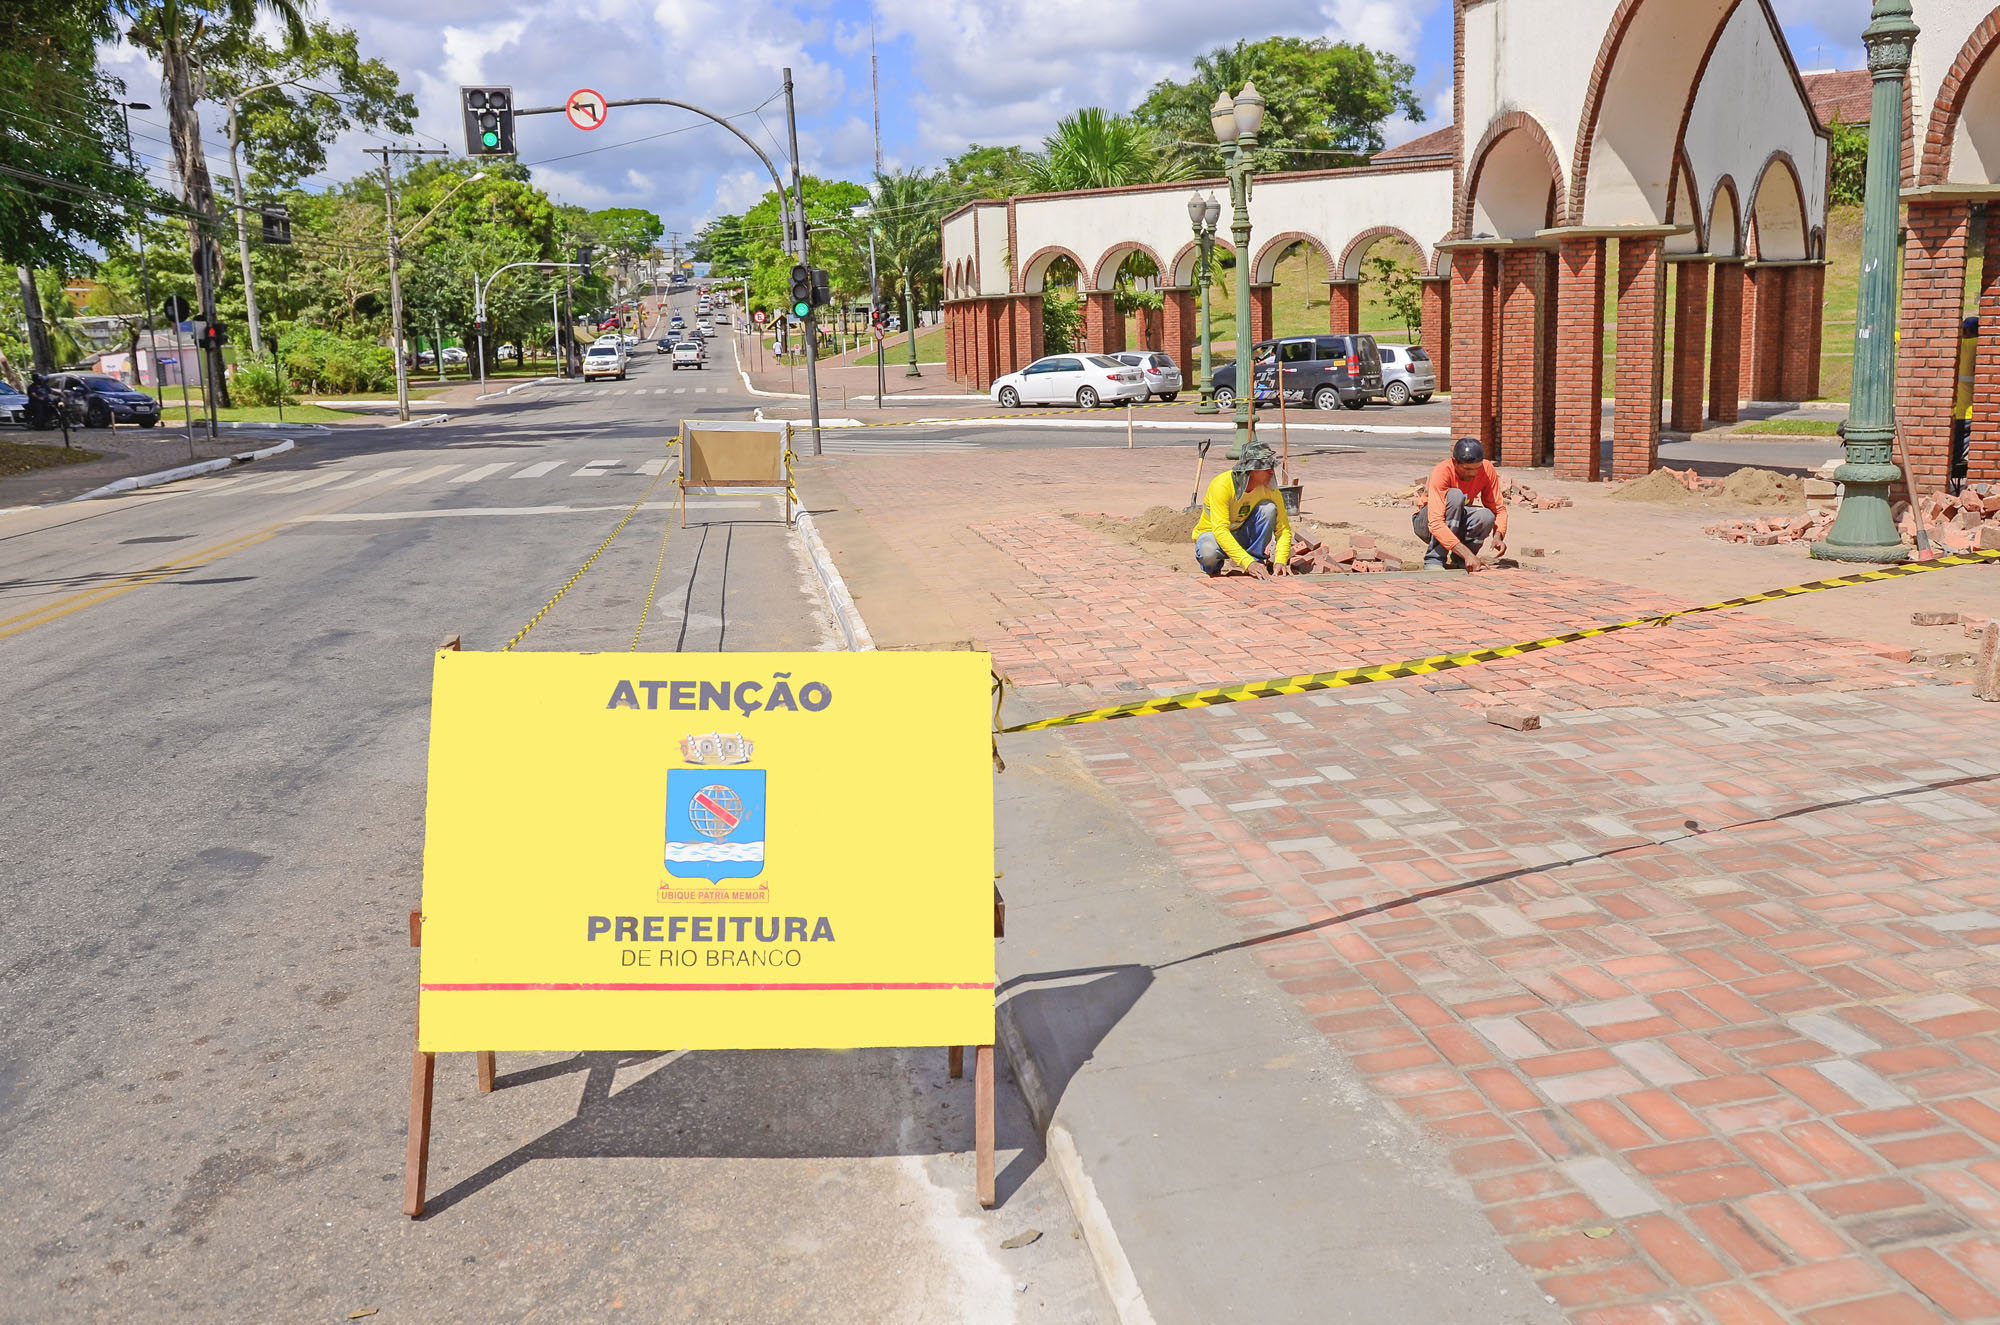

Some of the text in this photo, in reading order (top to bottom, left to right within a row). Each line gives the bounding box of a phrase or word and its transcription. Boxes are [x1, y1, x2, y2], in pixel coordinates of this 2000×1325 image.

[607, 672, 832, 717] ATENÇÃO
[661, 891, 765, 900] UBIQUE PATRIA MEMOR
[588, 916, 834, 943] PREFEITURA
[622, 949, 801, 967] DE RIO BRANCO
